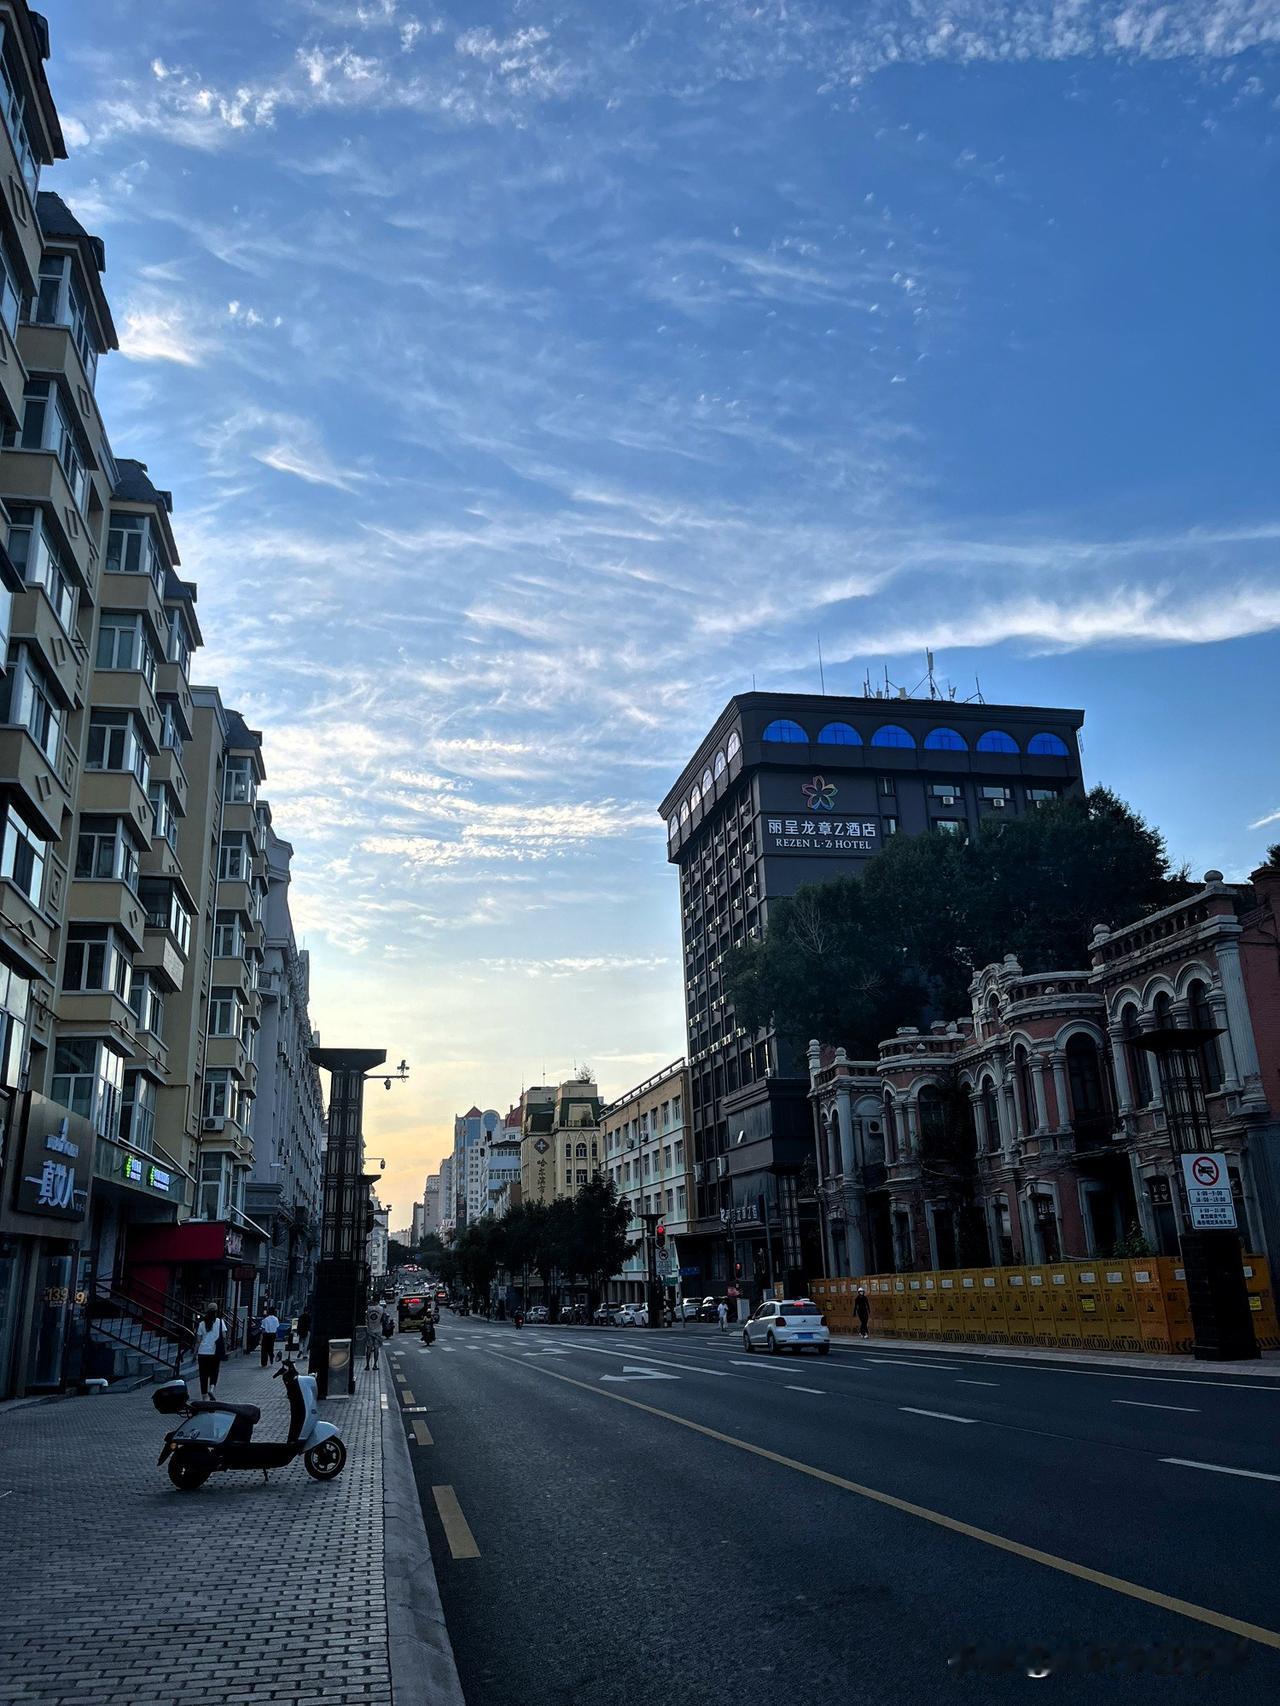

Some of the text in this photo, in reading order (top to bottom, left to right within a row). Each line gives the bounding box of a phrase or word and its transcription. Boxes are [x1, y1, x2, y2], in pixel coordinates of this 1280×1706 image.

[768, 819, 876, 837] 丽呈龙章Z酒店
[776, 838, 810, 848] REZEN
[835, 839, 872, 850] HOTEL
